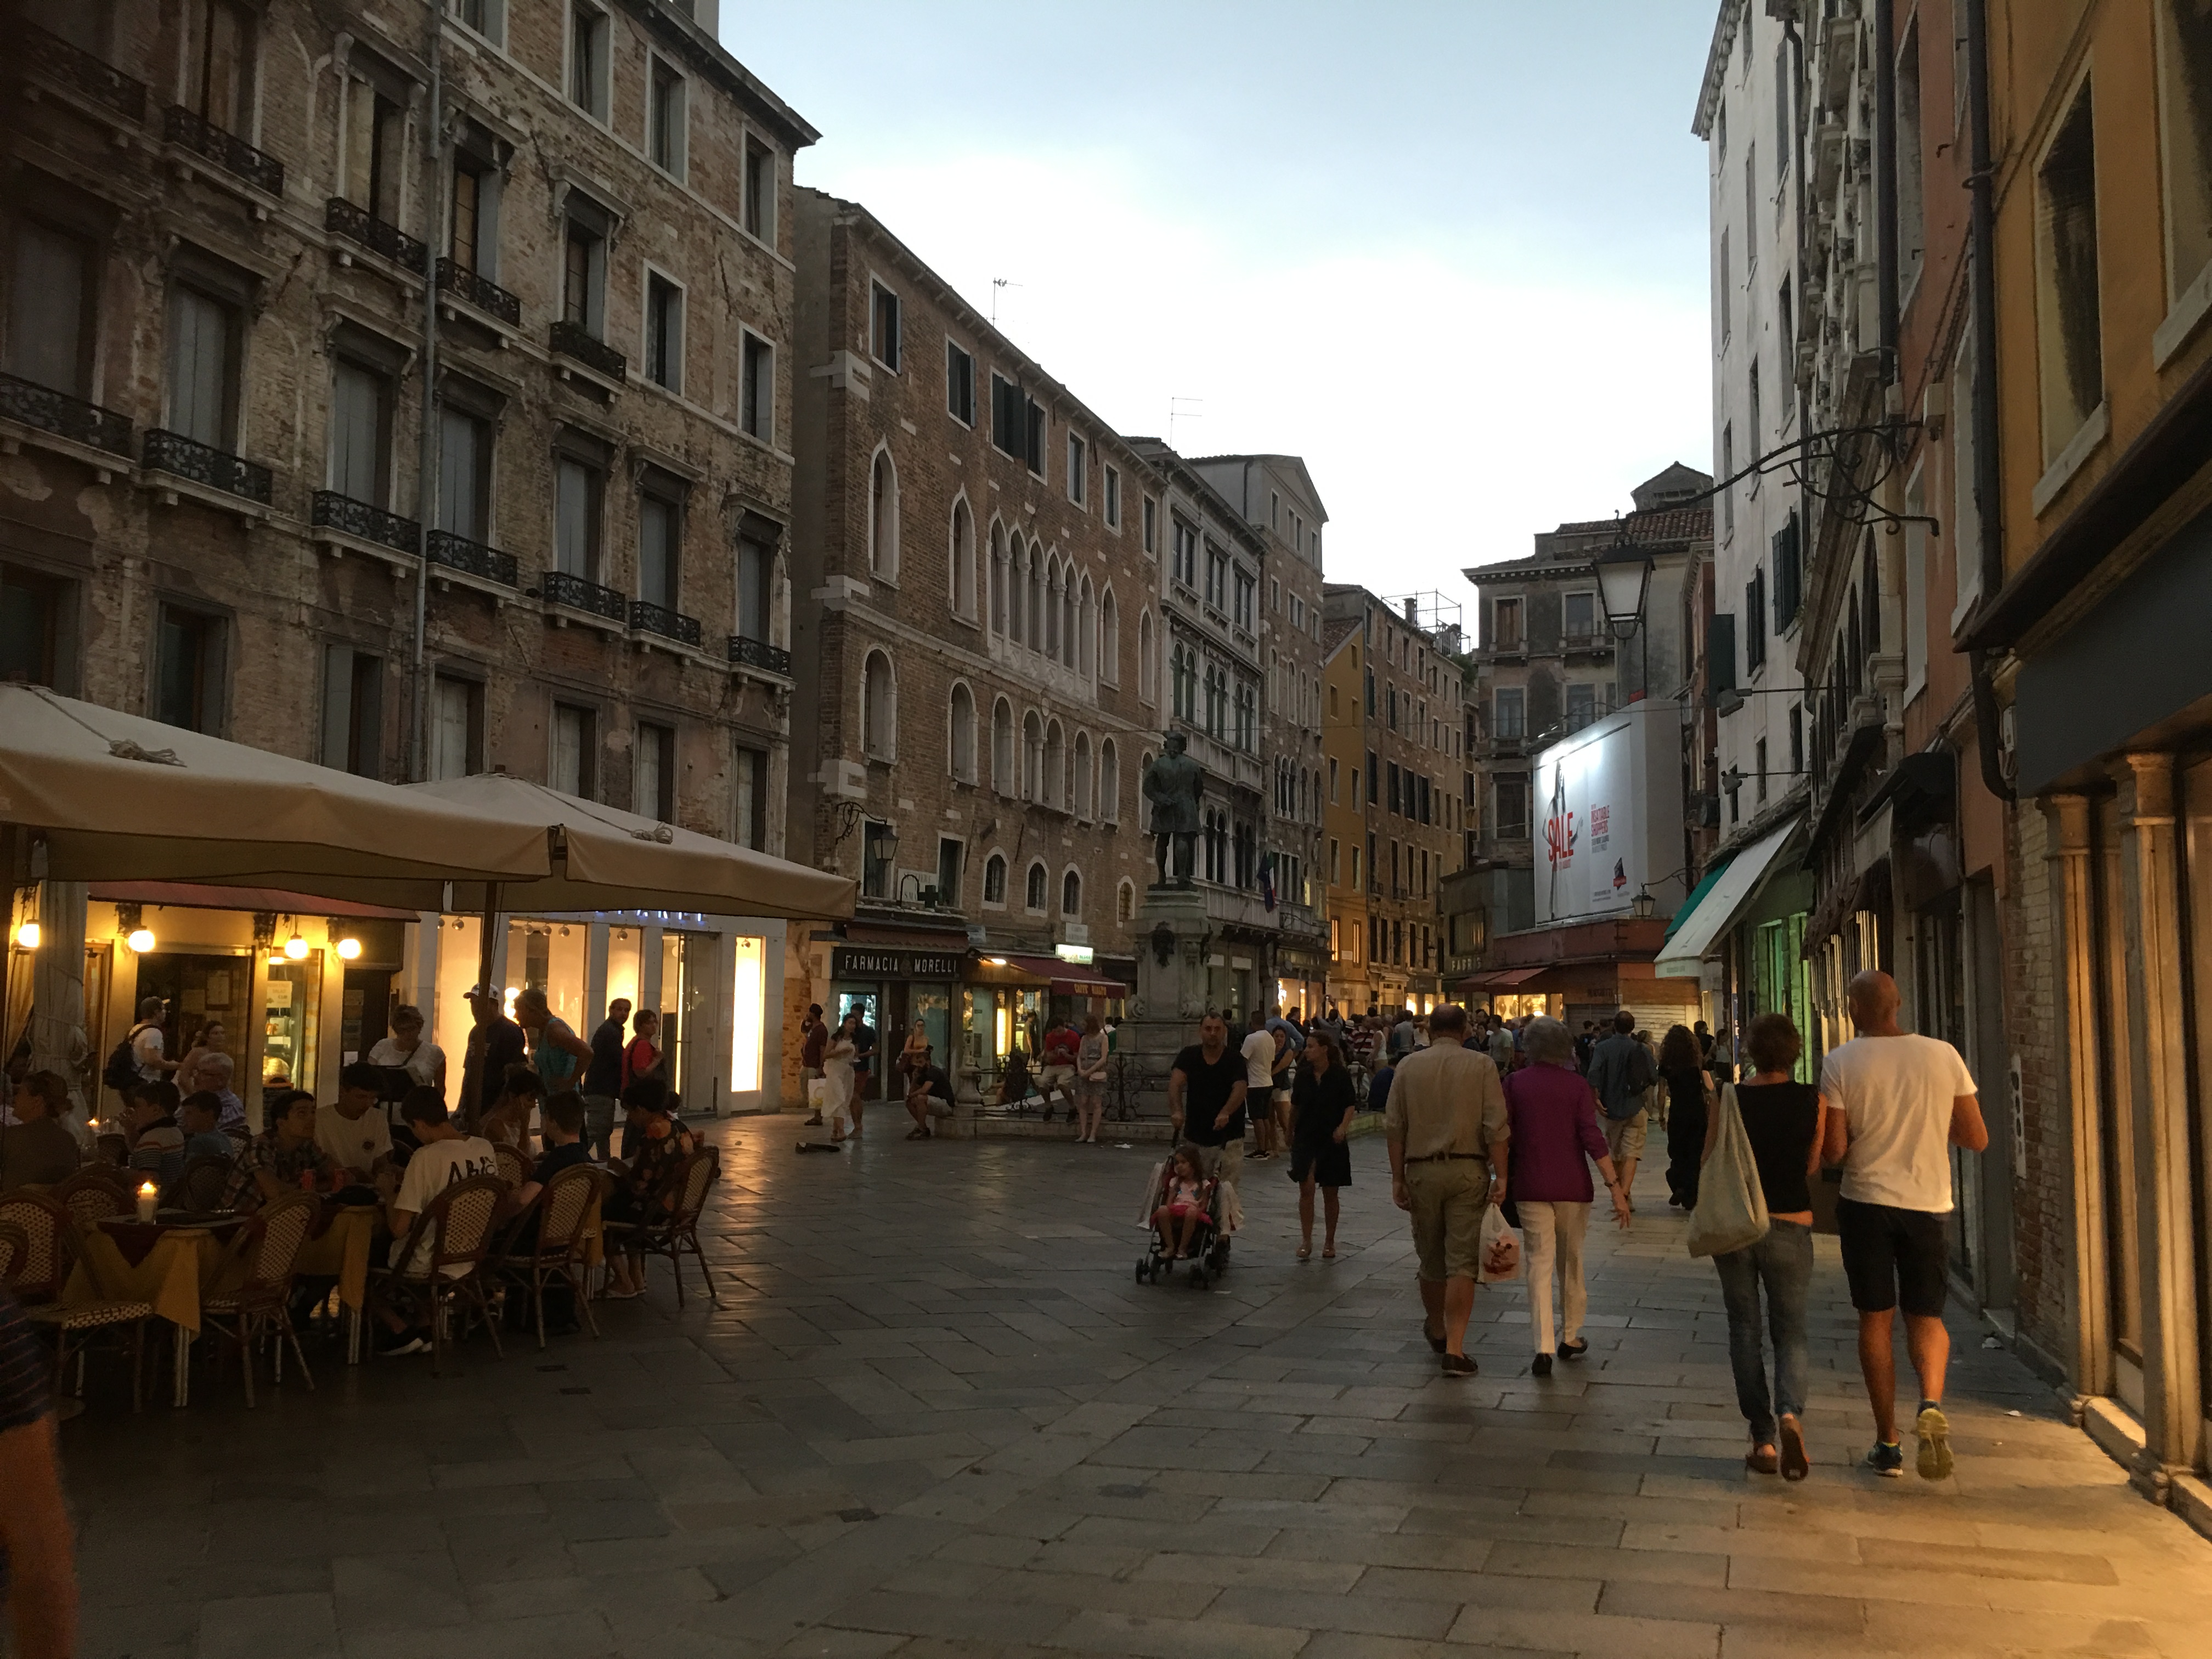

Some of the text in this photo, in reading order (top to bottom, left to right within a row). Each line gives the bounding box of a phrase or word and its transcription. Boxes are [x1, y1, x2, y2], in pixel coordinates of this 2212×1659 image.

[1548, 812, 1574, 862] SALE
[845, 955, 957, 973] FARMACIA MORELLI
